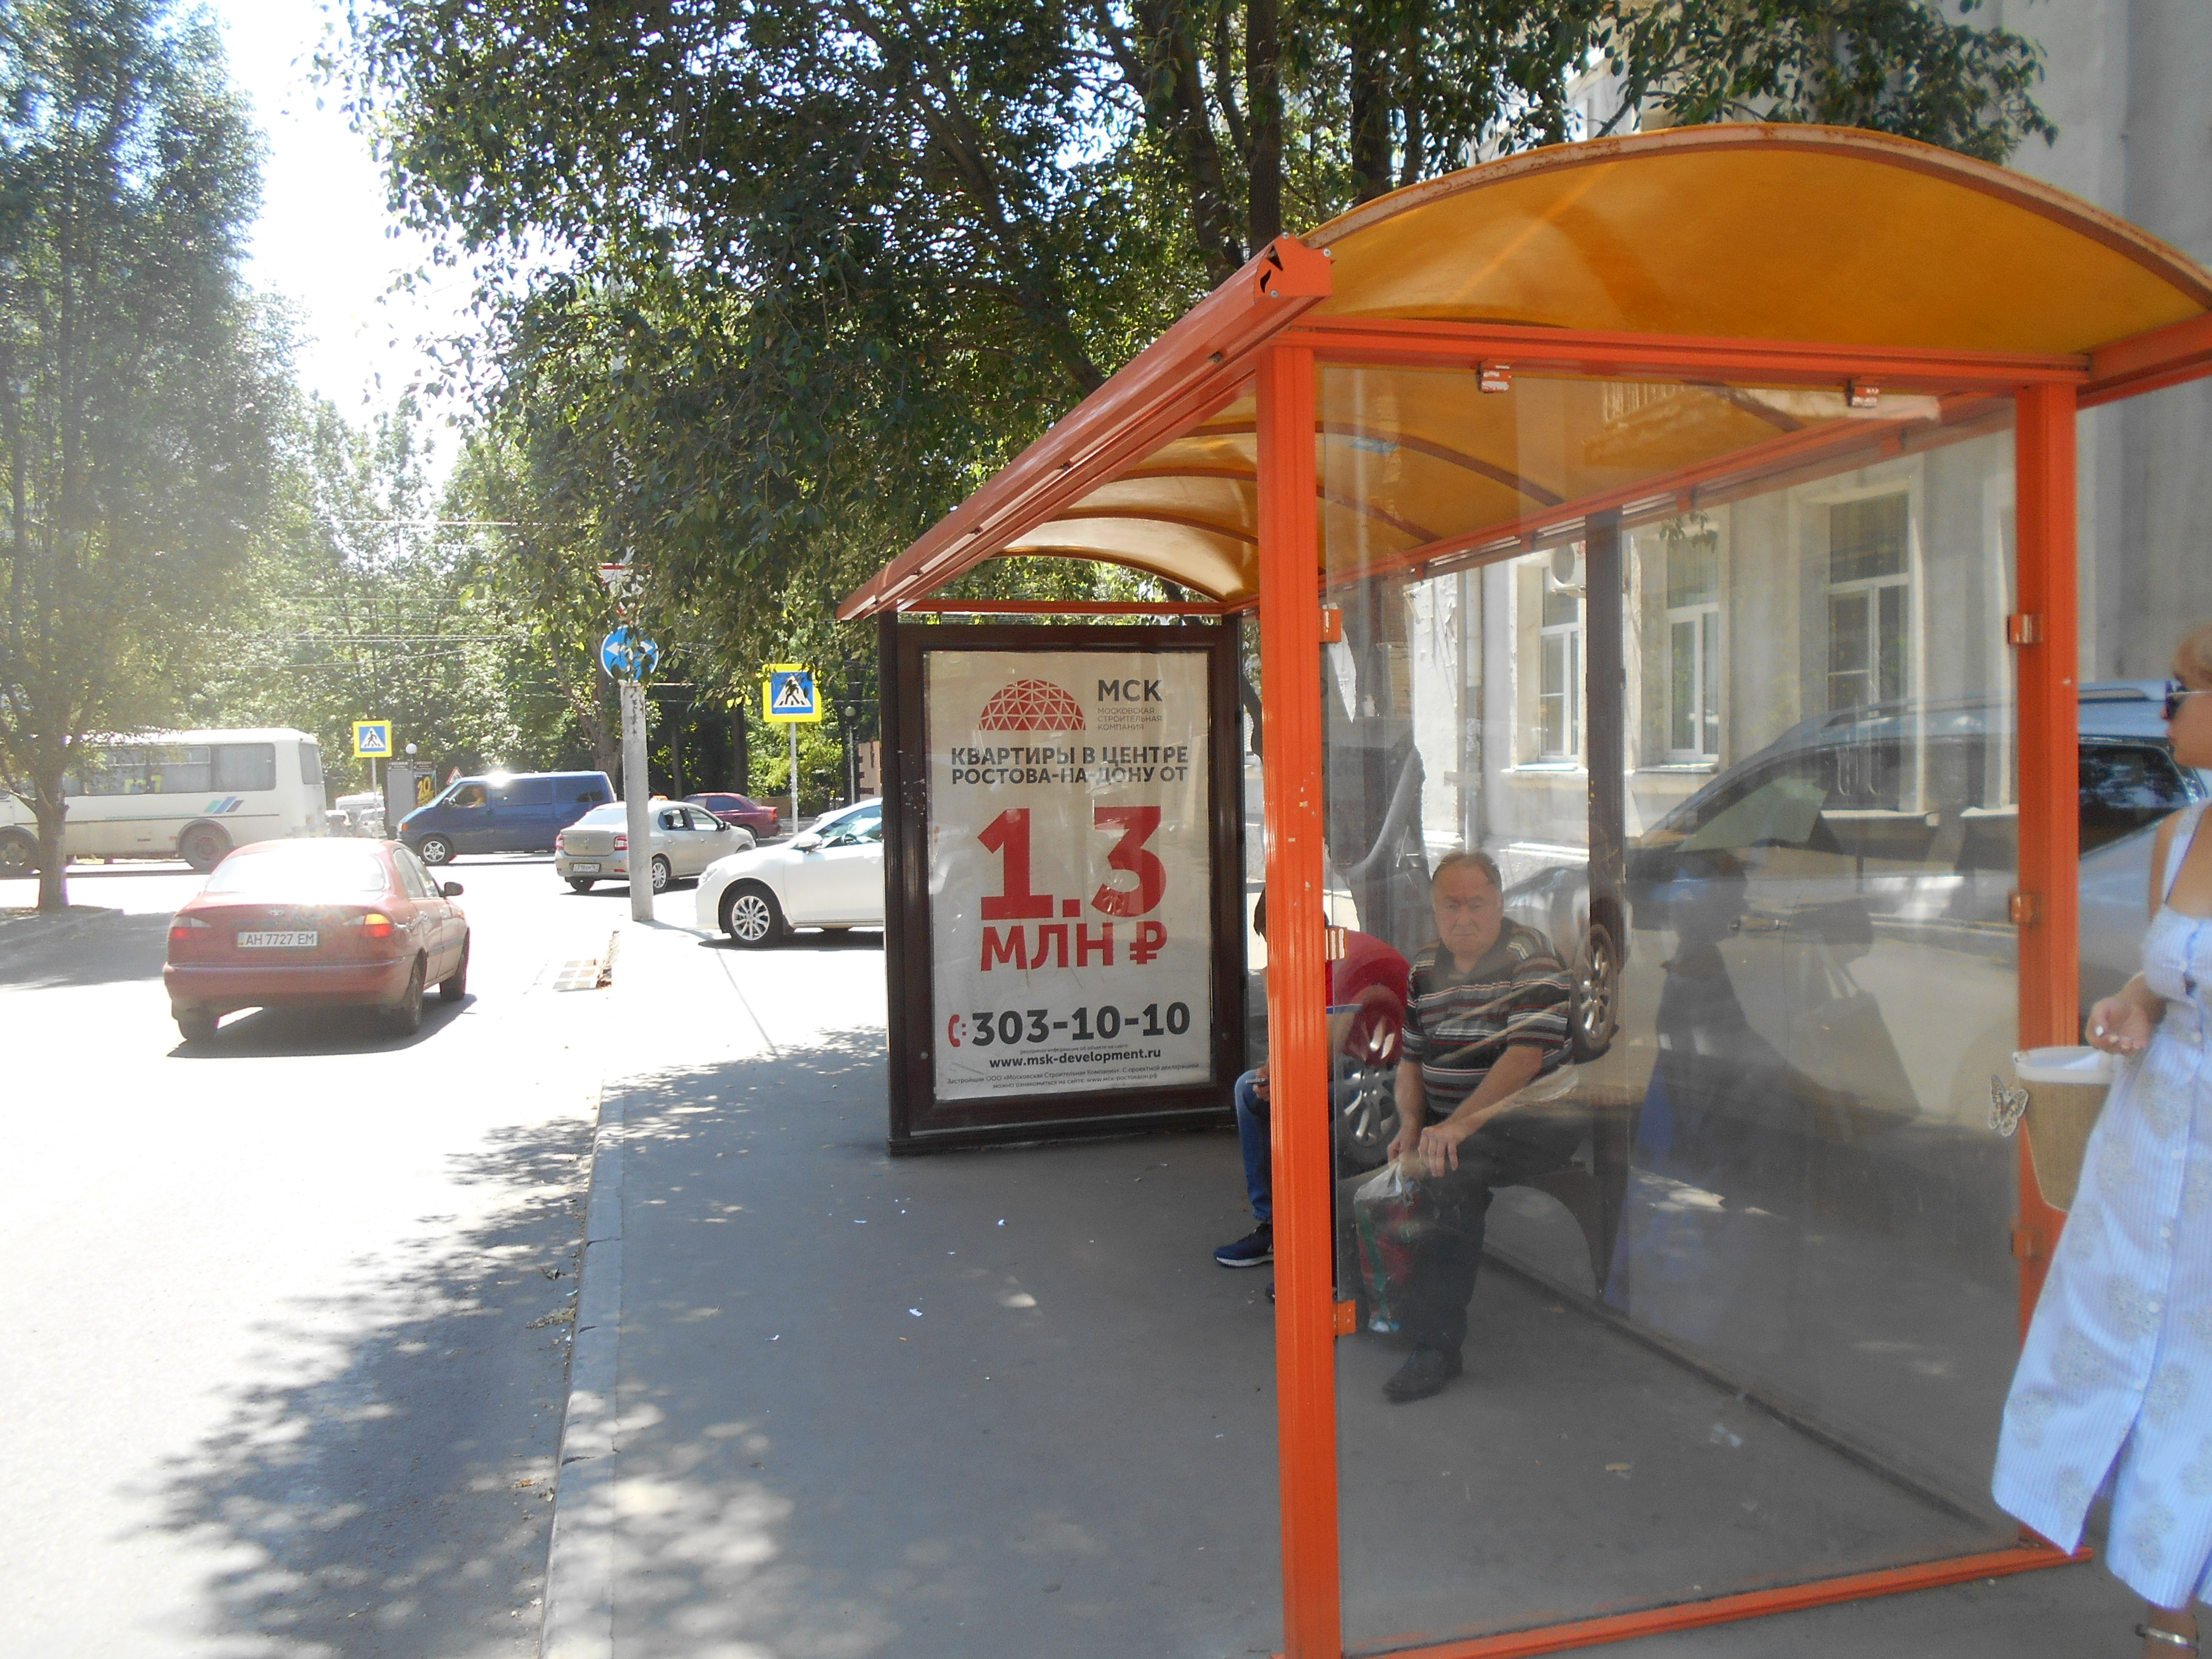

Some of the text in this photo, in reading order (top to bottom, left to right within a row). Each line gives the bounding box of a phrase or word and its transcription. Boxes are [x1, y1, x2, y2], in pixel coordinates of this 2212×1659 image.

[1098, 679, 1162, 702] МСК
[951, 745, 1188, 766] КВАРТИРЫ В ЦЕНТРЕ
[952, 766, 1188, 785] РОСТОВА-НА-ДОНУ ОТ
[977, 806, 1167, 920] 1.3
[267, 934, 293, 945] 7727
[980, 922, 1114, 971] МЛН
[972, 1002, 1190, 1046] 303-10-10
[990, 1048, 1161, 1068] www.msk-development.ru
[947, 1077, 985, 1085] Застройщик
[1044, 1070, 1086, 1079] Строительная
[1128, 1065, 1160, 1074] проектной
[1161, 1062, 1199, 1072] декларацией
[1015, 1079, 1057, 1088] ознакомиться
